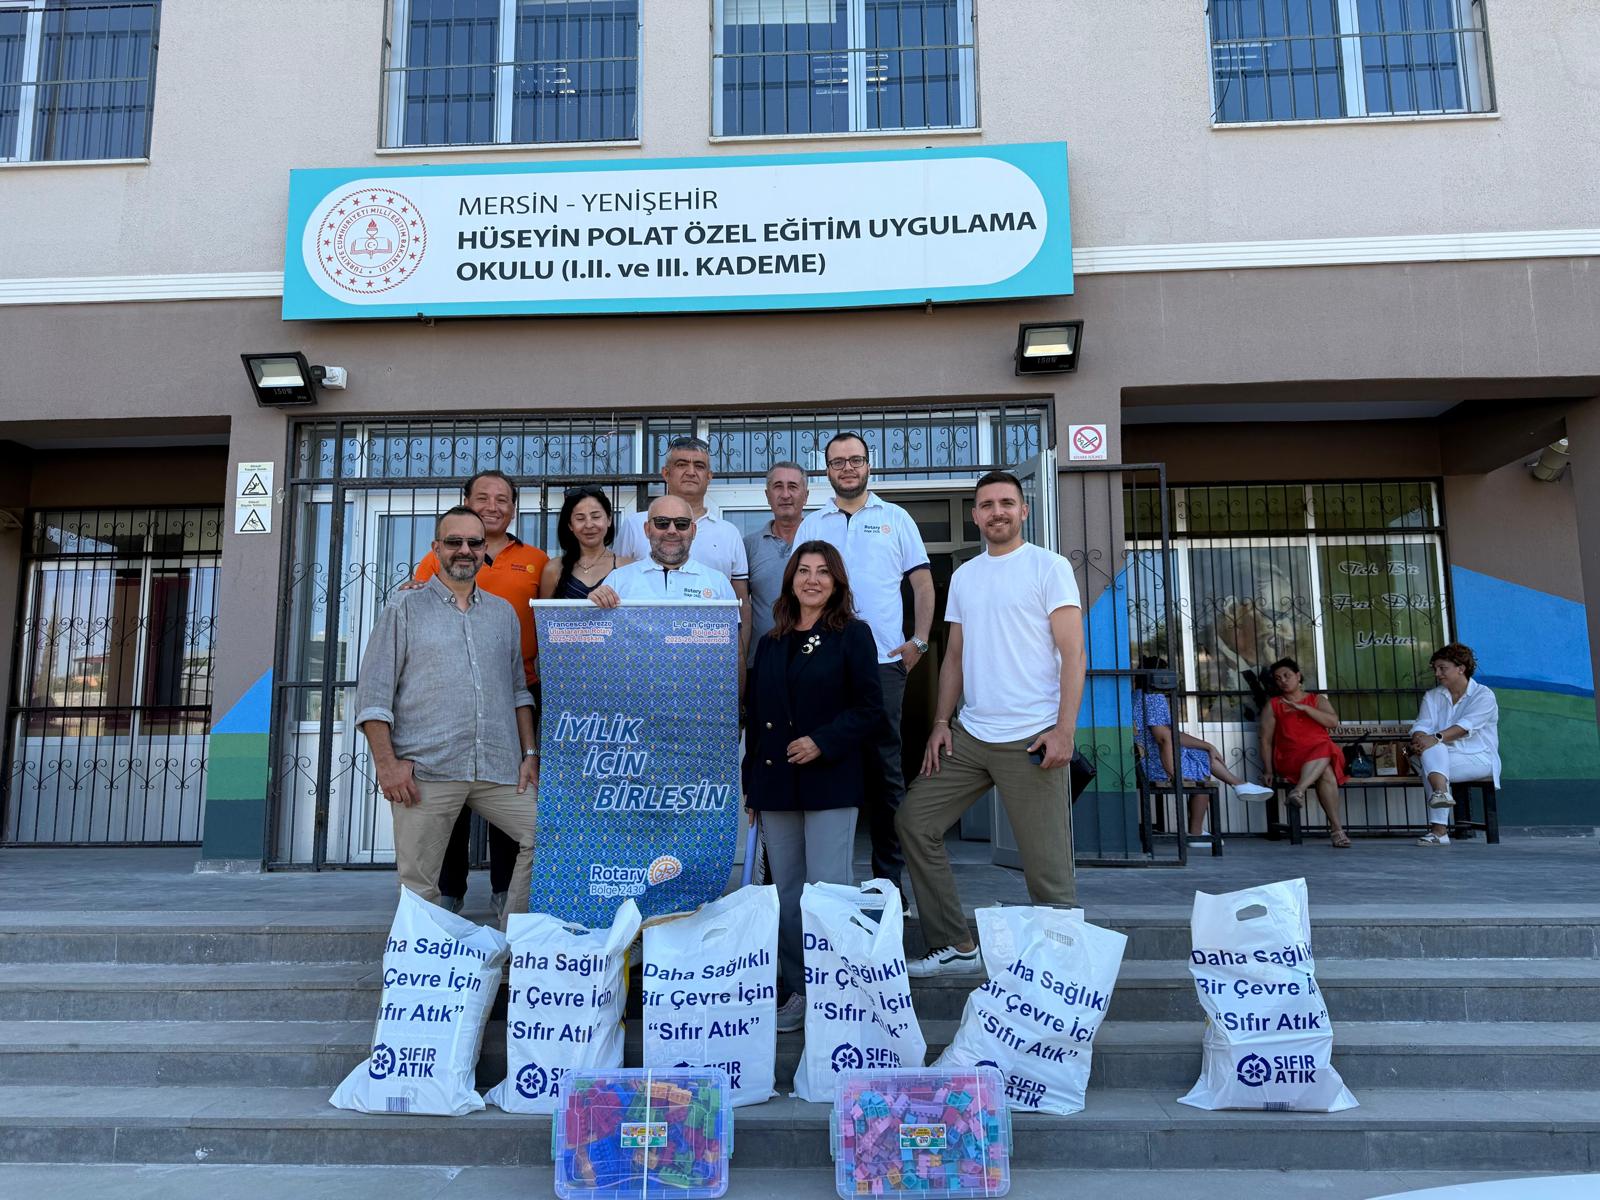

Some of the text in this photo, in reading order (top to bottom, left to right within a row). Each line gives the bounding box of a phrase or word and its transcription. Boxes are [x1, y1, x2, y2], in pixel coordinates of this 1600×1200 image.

[458, 191, 559, 216] MERSİN
[581, 187, 718, 216] YENİŞEHİR
[458, 211, 1037, 250] HÜSEYİN POLAT ÖZEL EĞİTİM UYGULAMA
[456, 252, 827, 282] OKULU (I.II. ve III. KADEME)
[554, 711, 644, 743] İYİLİK
[583, 746, 648, 779] İÇİN
[594, 780, 729, 814] BİRLEŞİN
[590, 864, 646, 883] Rotary
[590, 883, 645, 897] Bölge 2430
[384, 936, 407, 953] ha
[803, 932, 834, 952] Da
[643, 948, 770, 981] Daha Sağlıklı
[1191, 949, 1248, 967] Daha
[384, 966, 482, 993] Çevre İçin
[804, 966, 830, 985] Bir
[526, 986, 585, 1010] Çevre
[670, 990, 732, 1010] Çevre
[738, 981, 775, 1006] İçin
[1233, 979, 1300, 999] Çevre
[409, 1003, 465, 1023] Atık”
[813, 1001, 909, 1039] “Sıfır Ak”
[1005, 993, 1065, 1032] Çevre
[1215, 1011, 1328, 1031] “Sıfır Atık”
[648, 1017, 760, 1041] “Sıfır Atık”
[977, 1009, 1079, 1064] “Sıfır Atık”
[399, 1047, 437, 1063] SIFIR
[866, 1047, 902, 1066] SIFIR
[1273, 1054, 1316, 1070] SIFIR
[397, 1063, 434, 1078] ATIK
[1275, 1070, 1317, 1084] ATIK
[1004, 1085, 1043, 1108] ATIK
